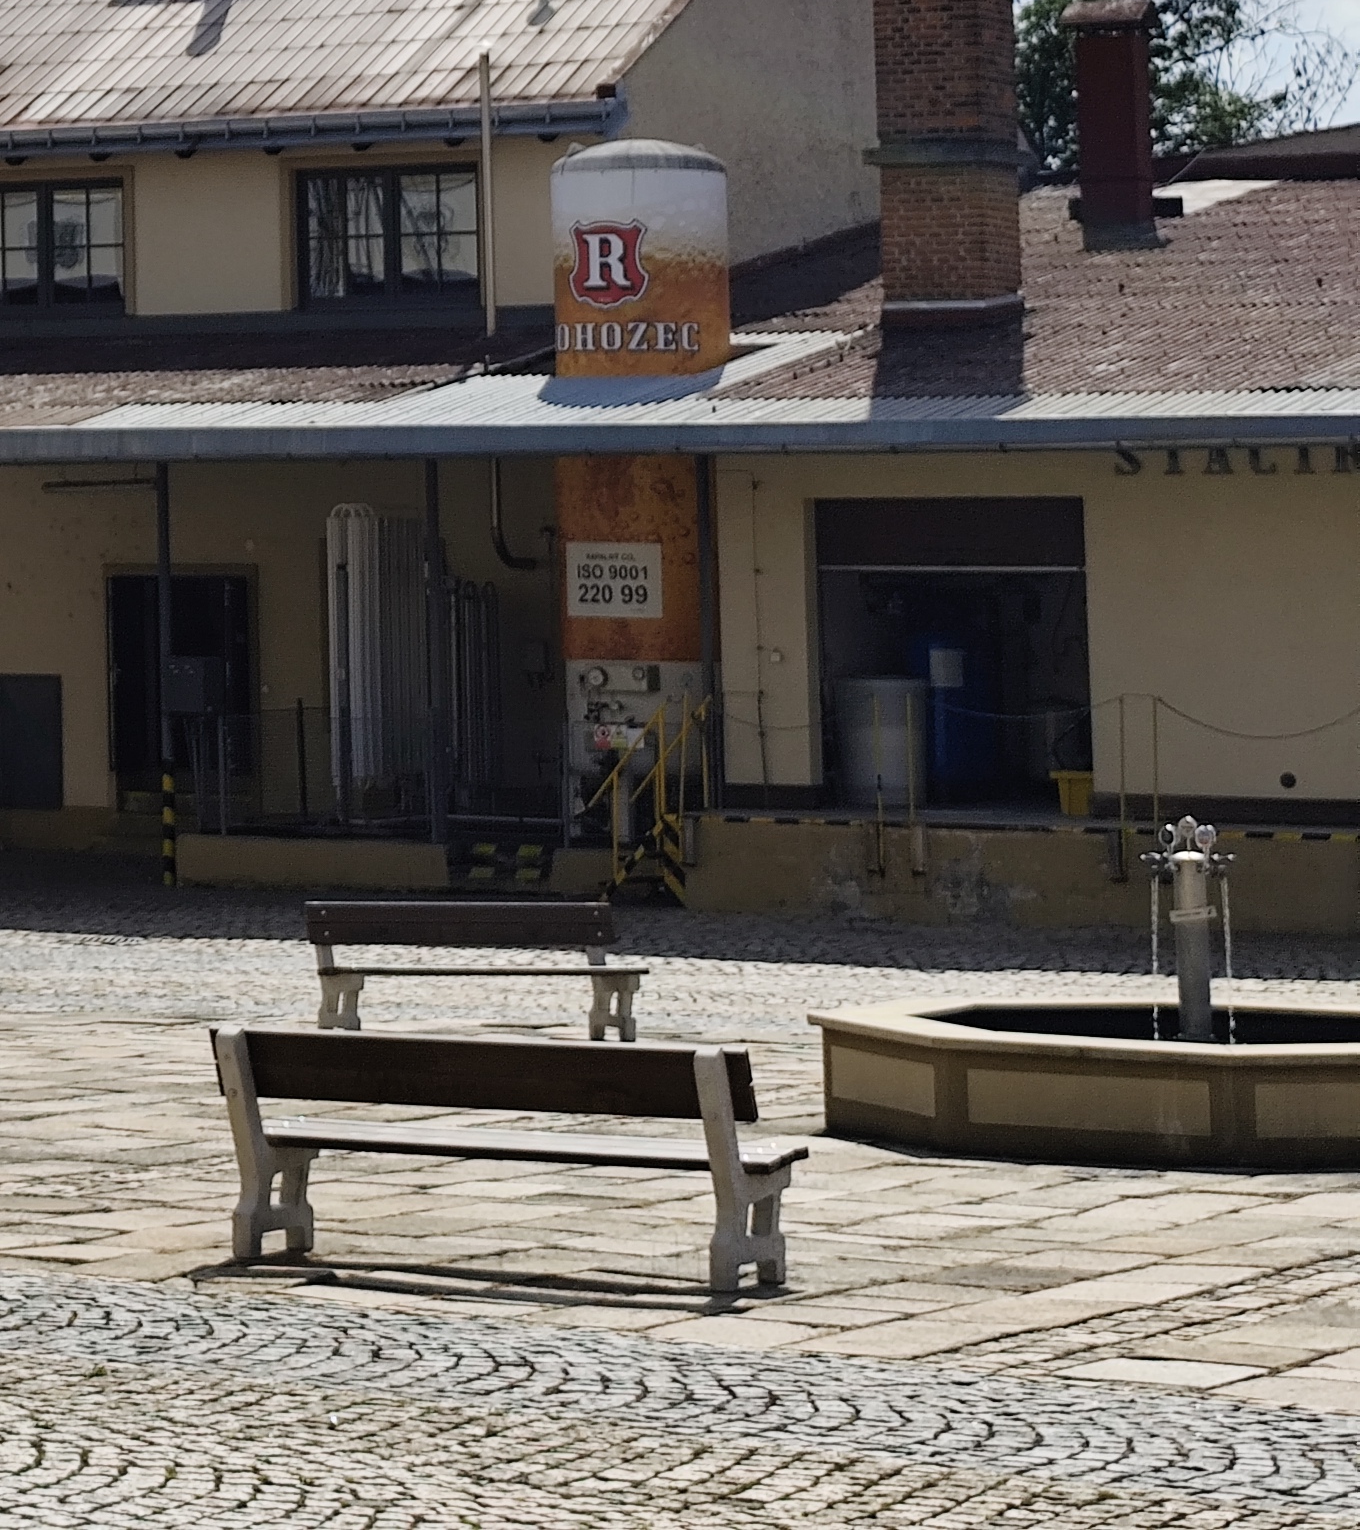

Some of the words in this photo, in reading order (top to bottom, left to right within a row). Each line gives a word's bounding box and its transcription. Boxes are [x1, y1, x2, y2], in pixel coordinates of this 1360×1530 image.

[582, 233, 632, 289] R
[557, 322, 700, 351] OHOZEC
[577, 563, 604, 579] ISO
[608, 564, 648, 580] 9001
[578, 583, 613, 603] 220
[621, 584, 648, 604] 99
